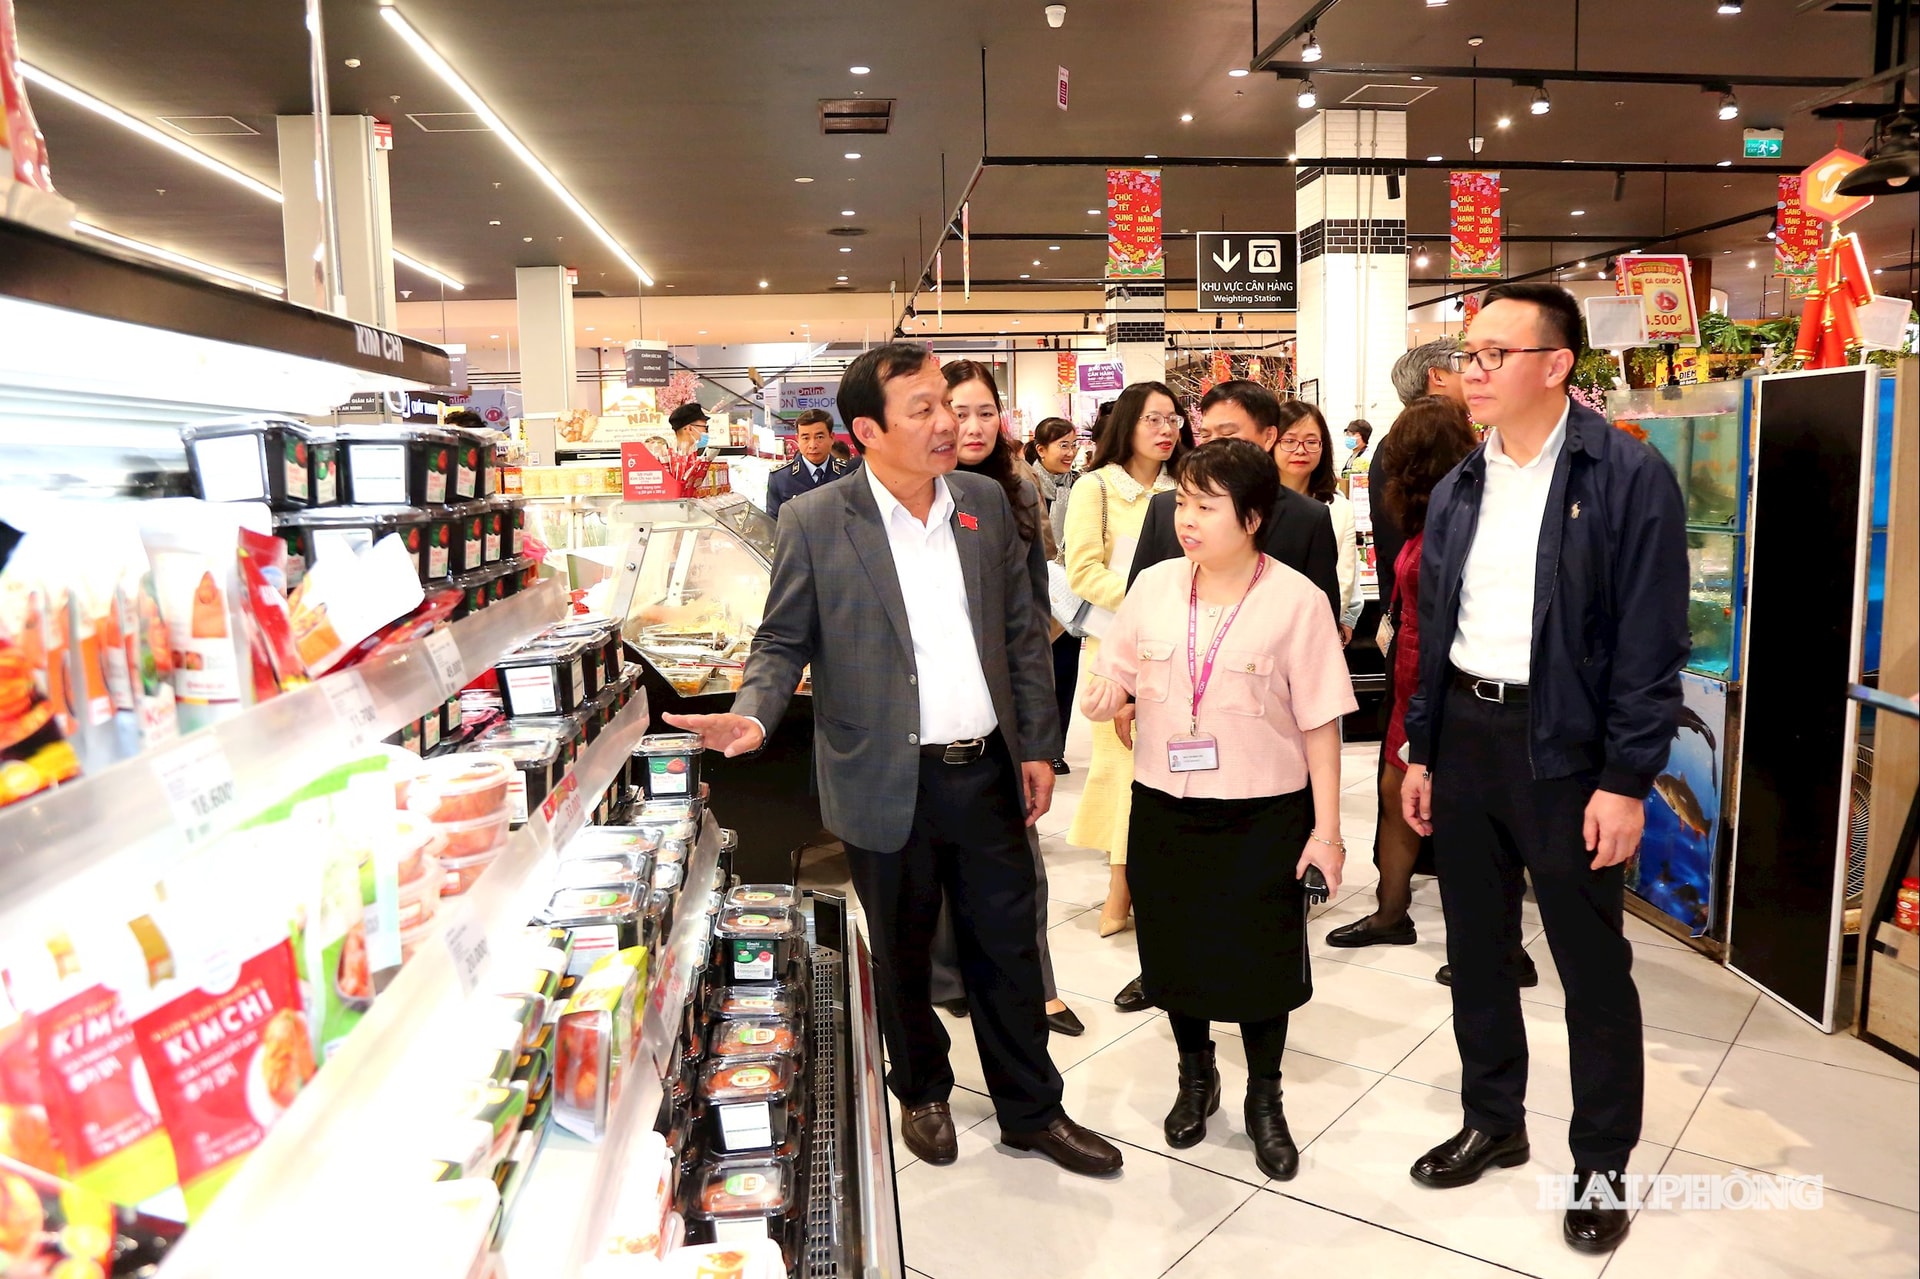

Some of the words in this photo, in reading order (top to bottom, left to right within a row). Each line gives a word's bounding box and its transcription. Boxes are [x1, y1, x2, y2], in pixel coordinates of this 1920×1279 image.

[1114, 213, 1133, 222] SUNG
[1201, 282, 1221, 292] KHU
[1223, 280, 1244, 294] VỰC
[1245, 279, 1265, 292] CÂN
[1267, 279, 1294, 292] HÀNG
[1213, 294, 1253, 305] Weighting
[1254, 294, 1282, 303] Station
[354, 323, 380, 358] KIM
[382, 331, 404, 363] CHI
[164, 987, 274, 1067] KIMCHI
